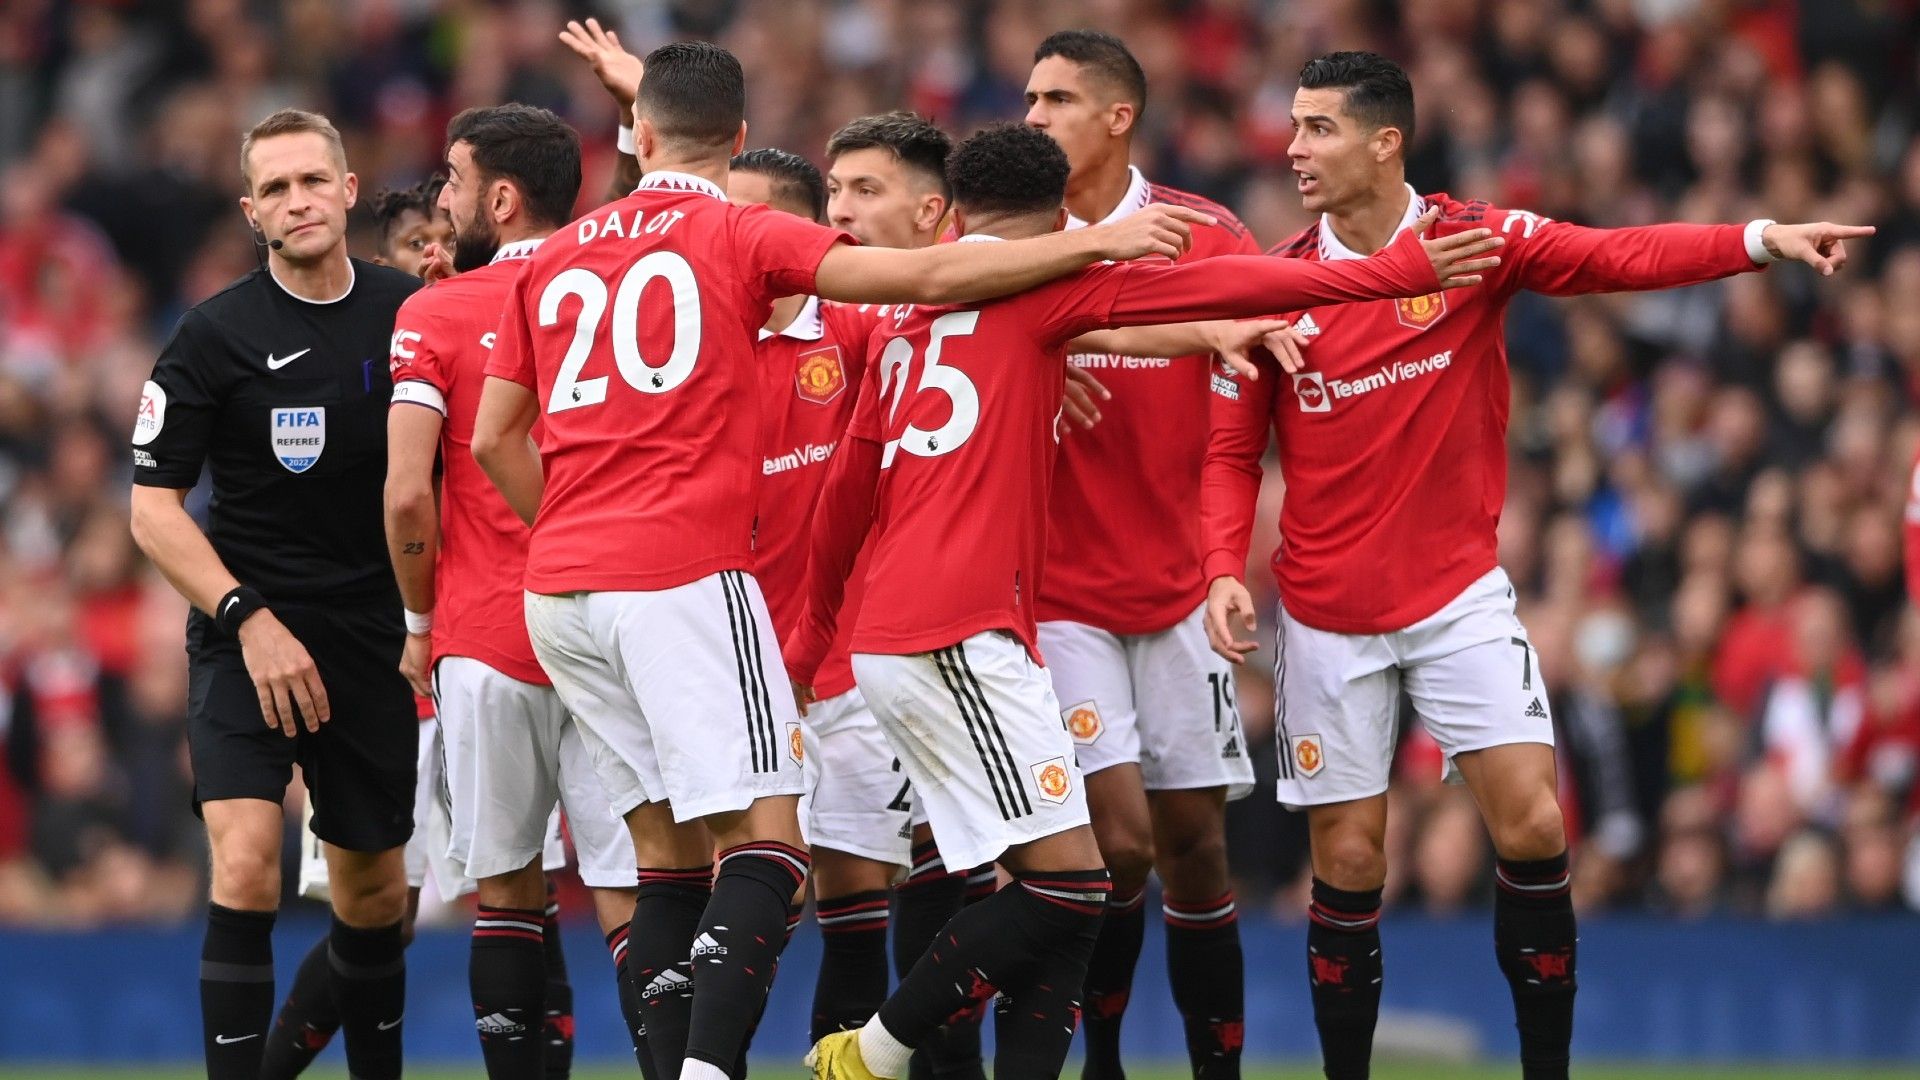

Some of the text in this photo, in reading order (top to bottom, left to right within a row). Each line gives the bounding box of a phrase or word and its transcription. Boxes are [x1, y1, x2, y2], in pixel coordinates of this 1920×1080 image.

[577, 209, 684, 245] DALOT
[538, 250, 702, 414] 20
[879, 310, 980, 469] 25
[1326, 350, 1452, 399] TeamViewer
[277, 411, 320, 428] FIFA
[276, 437, 321, 446] REFEREE
[288, 458, 309, 466] 2022
[403, 542, 425, 555] 23
[1510, 636, 1531, 691] 7
